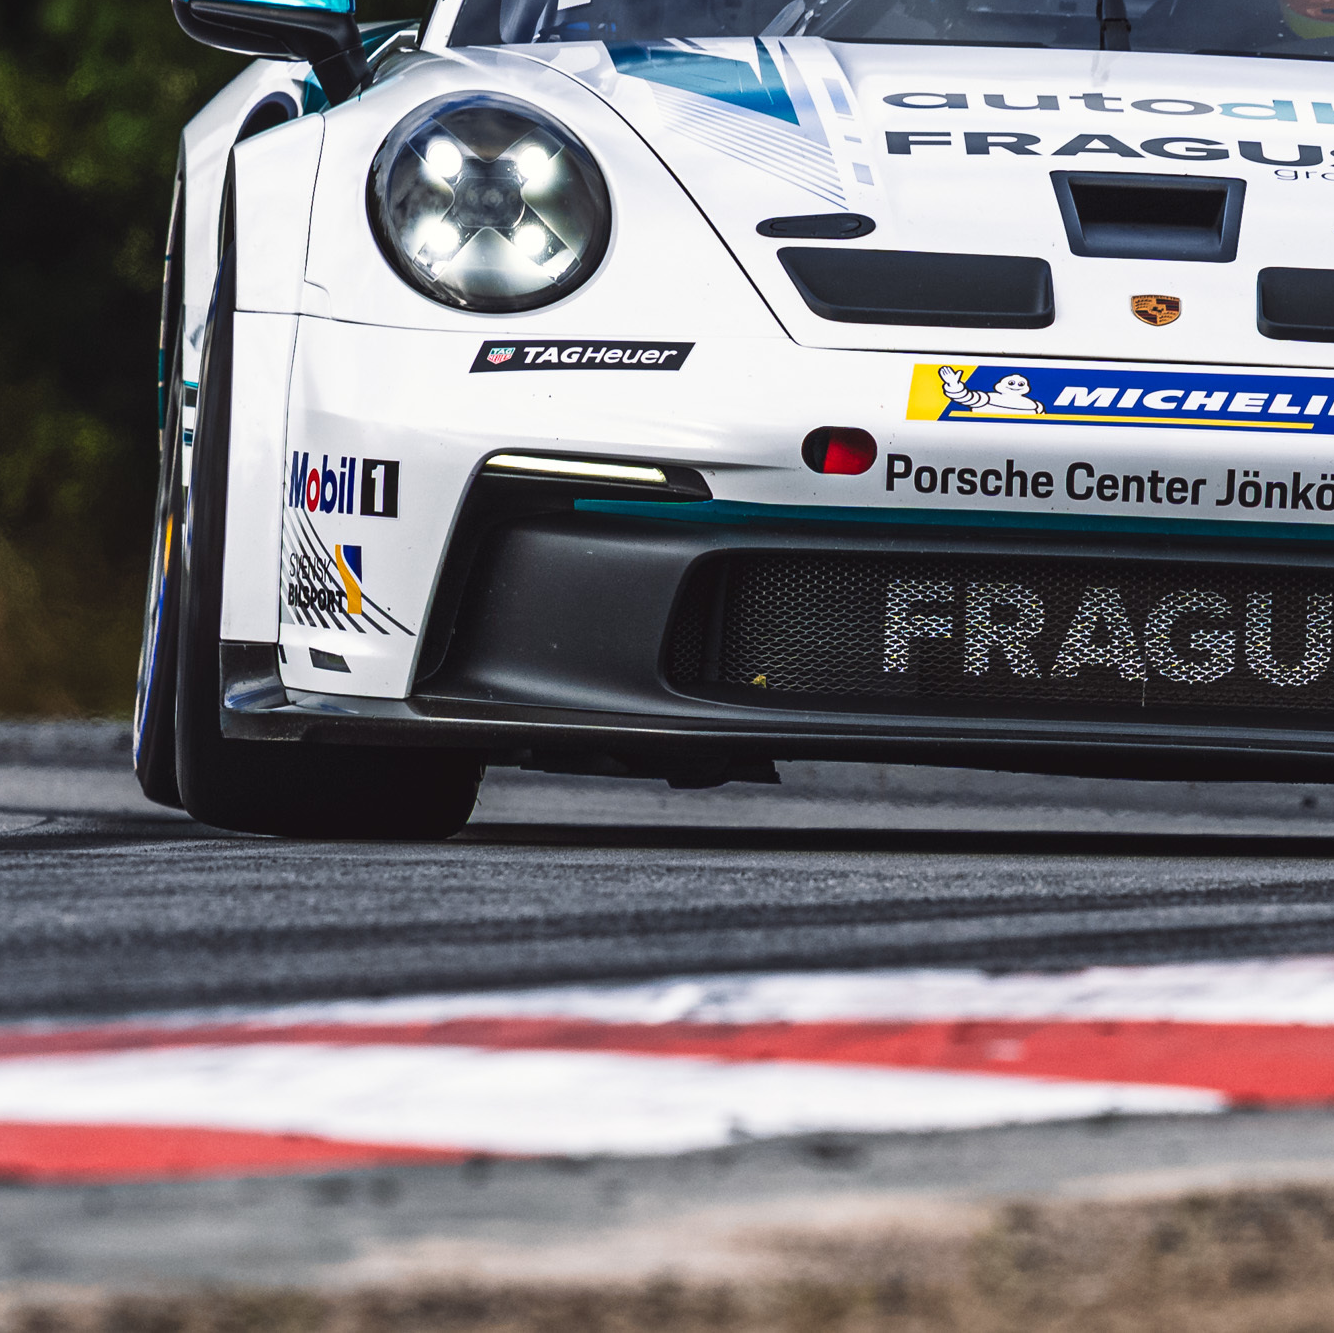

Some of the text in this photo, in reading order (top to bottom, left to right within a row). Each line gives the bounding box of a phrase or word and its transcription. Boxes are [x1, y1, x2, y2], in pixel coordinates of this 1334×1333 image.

[289, 451, 356, 515] Mobil
[885, 453, 1054, 501] Porsche
[1066, 462, 1208, 507] Center
[290, 553, 333, 584] SVENSK
[288, 583, 344, 614] BILSPORT
